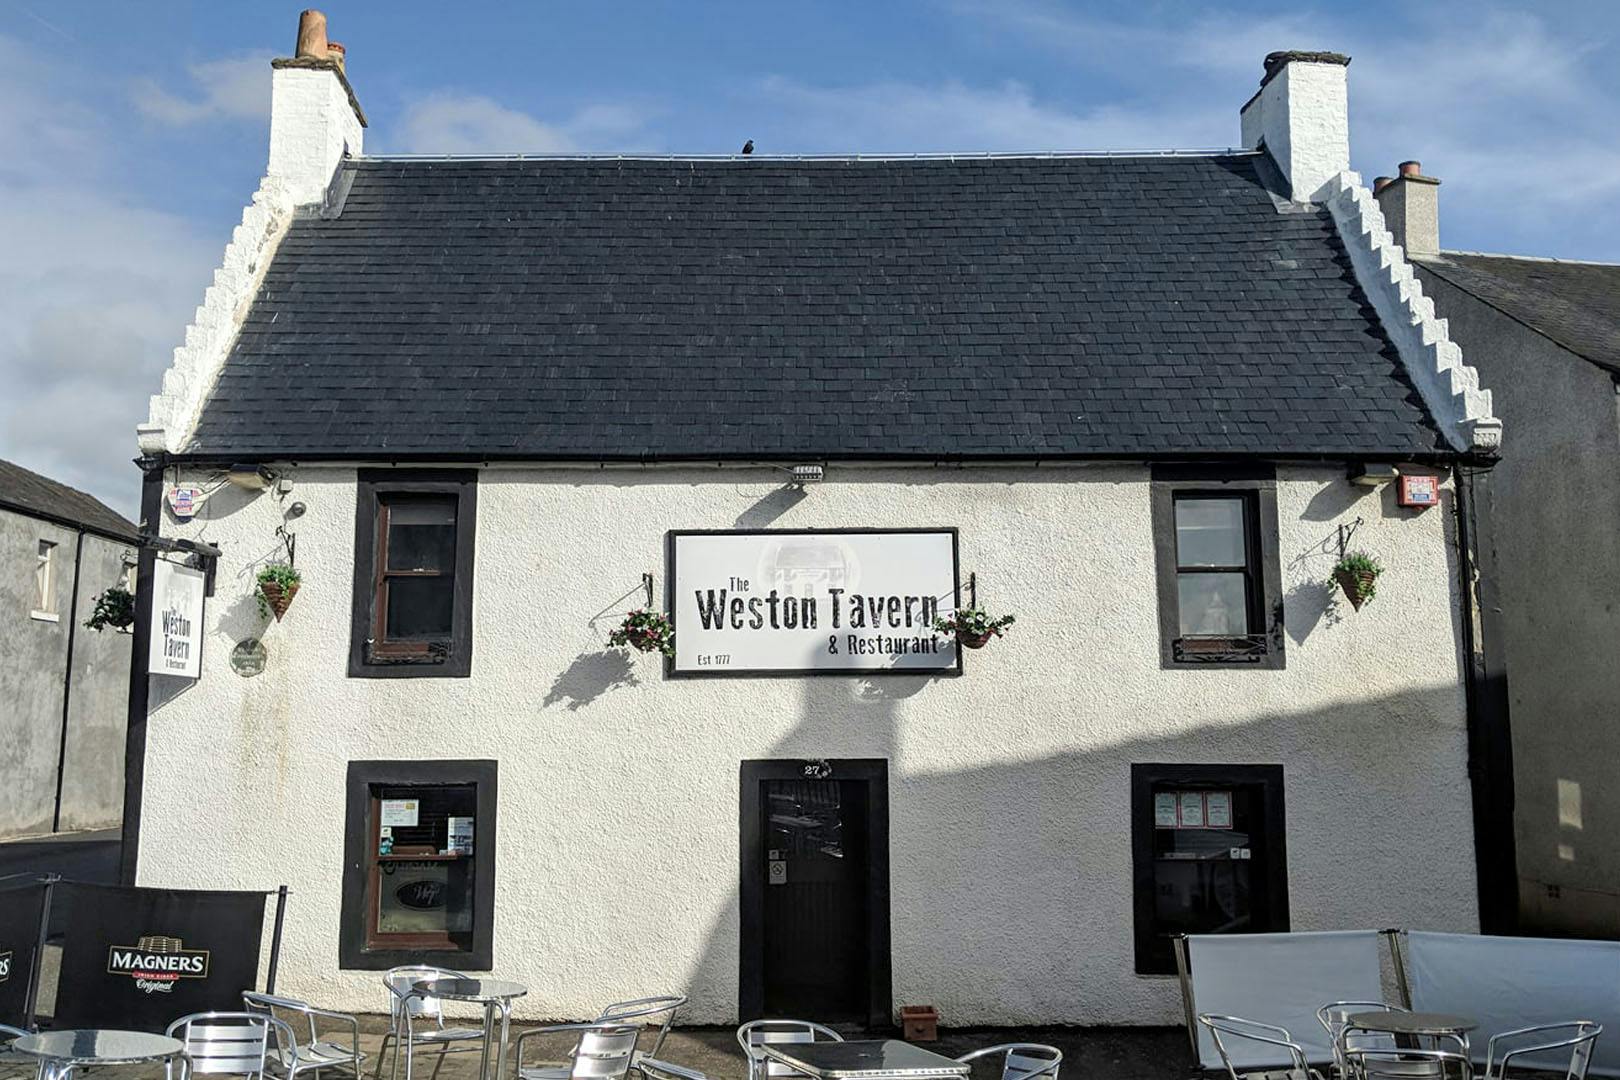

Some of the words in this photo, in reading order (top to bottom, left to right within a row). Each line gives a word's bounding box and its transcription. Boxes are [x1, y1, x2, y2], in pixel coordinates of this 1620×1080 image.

[730, 577, 749, 592] The
[695, 589, 817, 629] Weston
[829, 588, 938, 628] Tavern
[162, 610, 190, 637] Weston
[164, 634, 189, 659] Tavern
[829, 635, 838, 654] &
[848, 634, 938, 654] Restaurant
[698, 655, 711, 665] Est
[715, 654, 730, 665] 1777
[805, 766, 819, 775] 27
[112, 951, 204, 972] MAGNERS
[136, 979, 174, 993] Original
